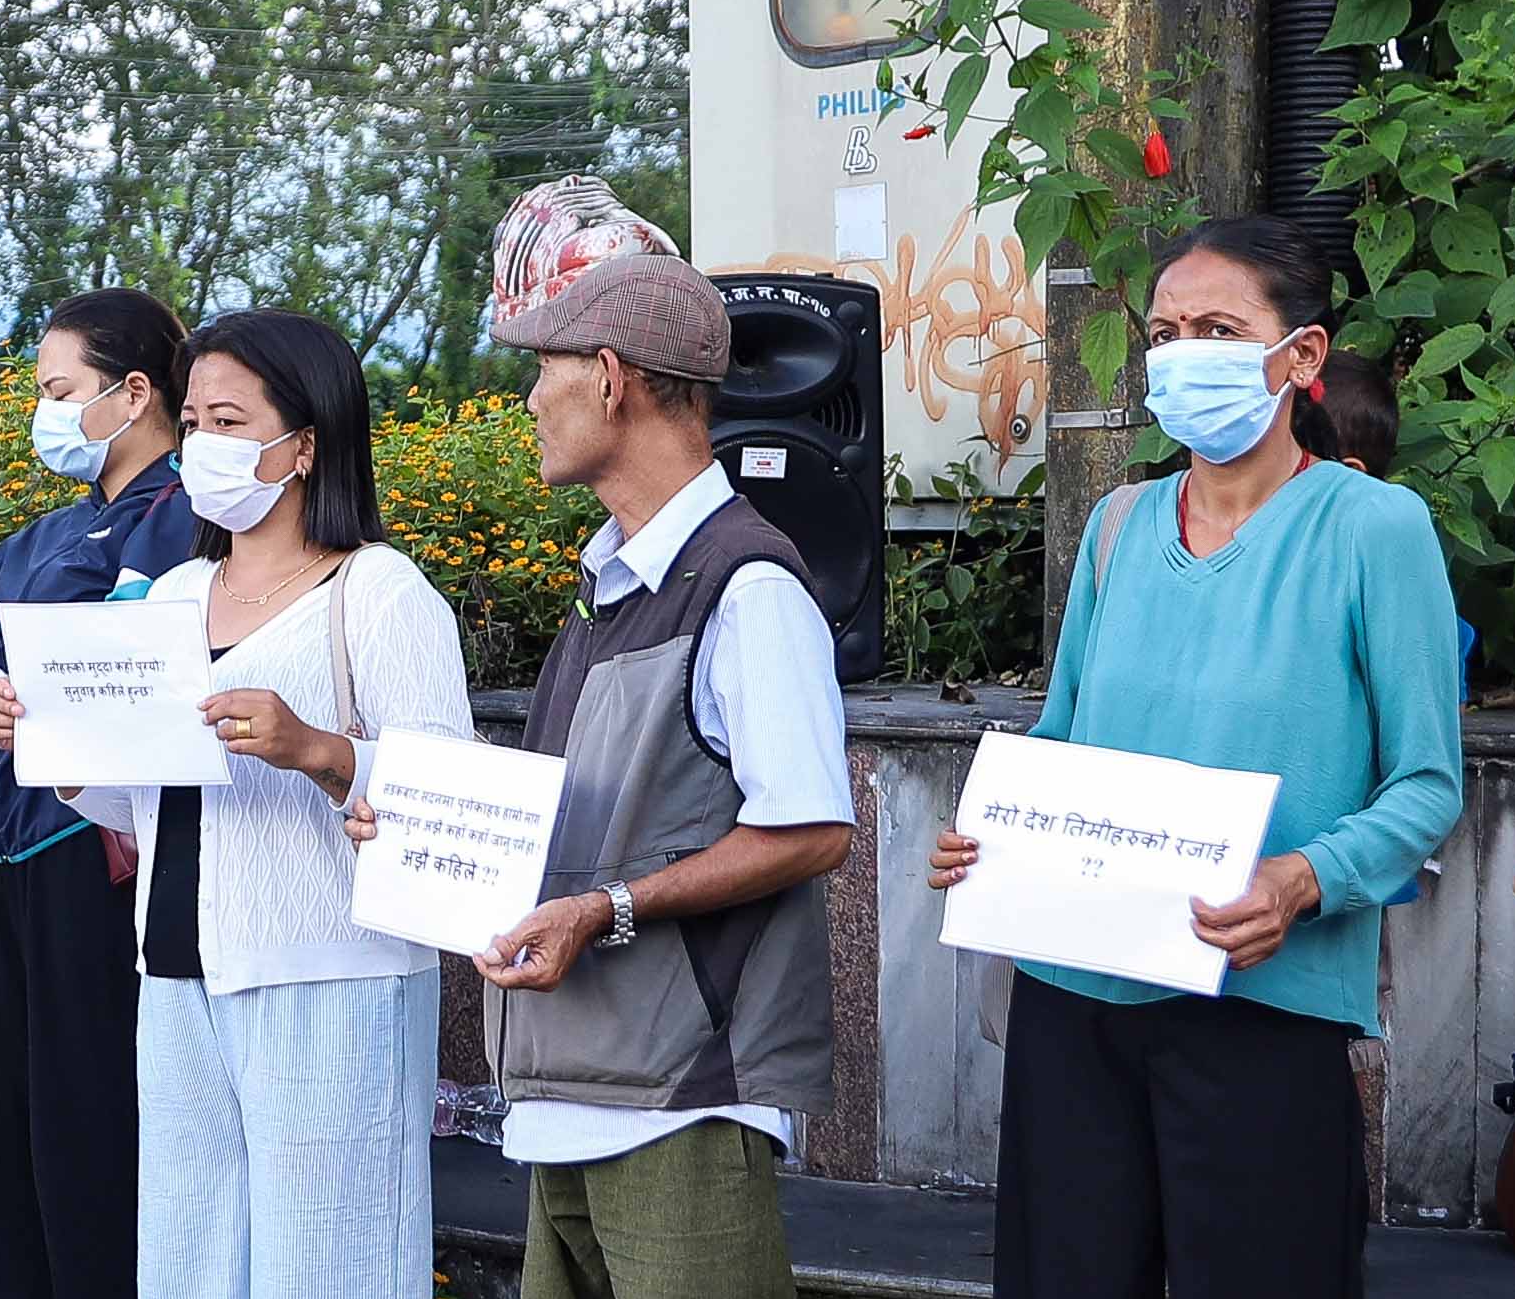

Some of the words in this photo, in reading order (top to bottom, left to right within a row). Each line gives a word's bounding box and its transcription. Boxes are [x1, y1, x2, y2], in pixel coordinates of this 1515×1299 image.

[982, 800, 1021, 828] मेरो
[1022, 808, 1059, 833] देश
[1174, 838, 1231, 866] रजाई
[400, 845, 430, 873] अझै
[433, 853, 478, 882] कहिले
